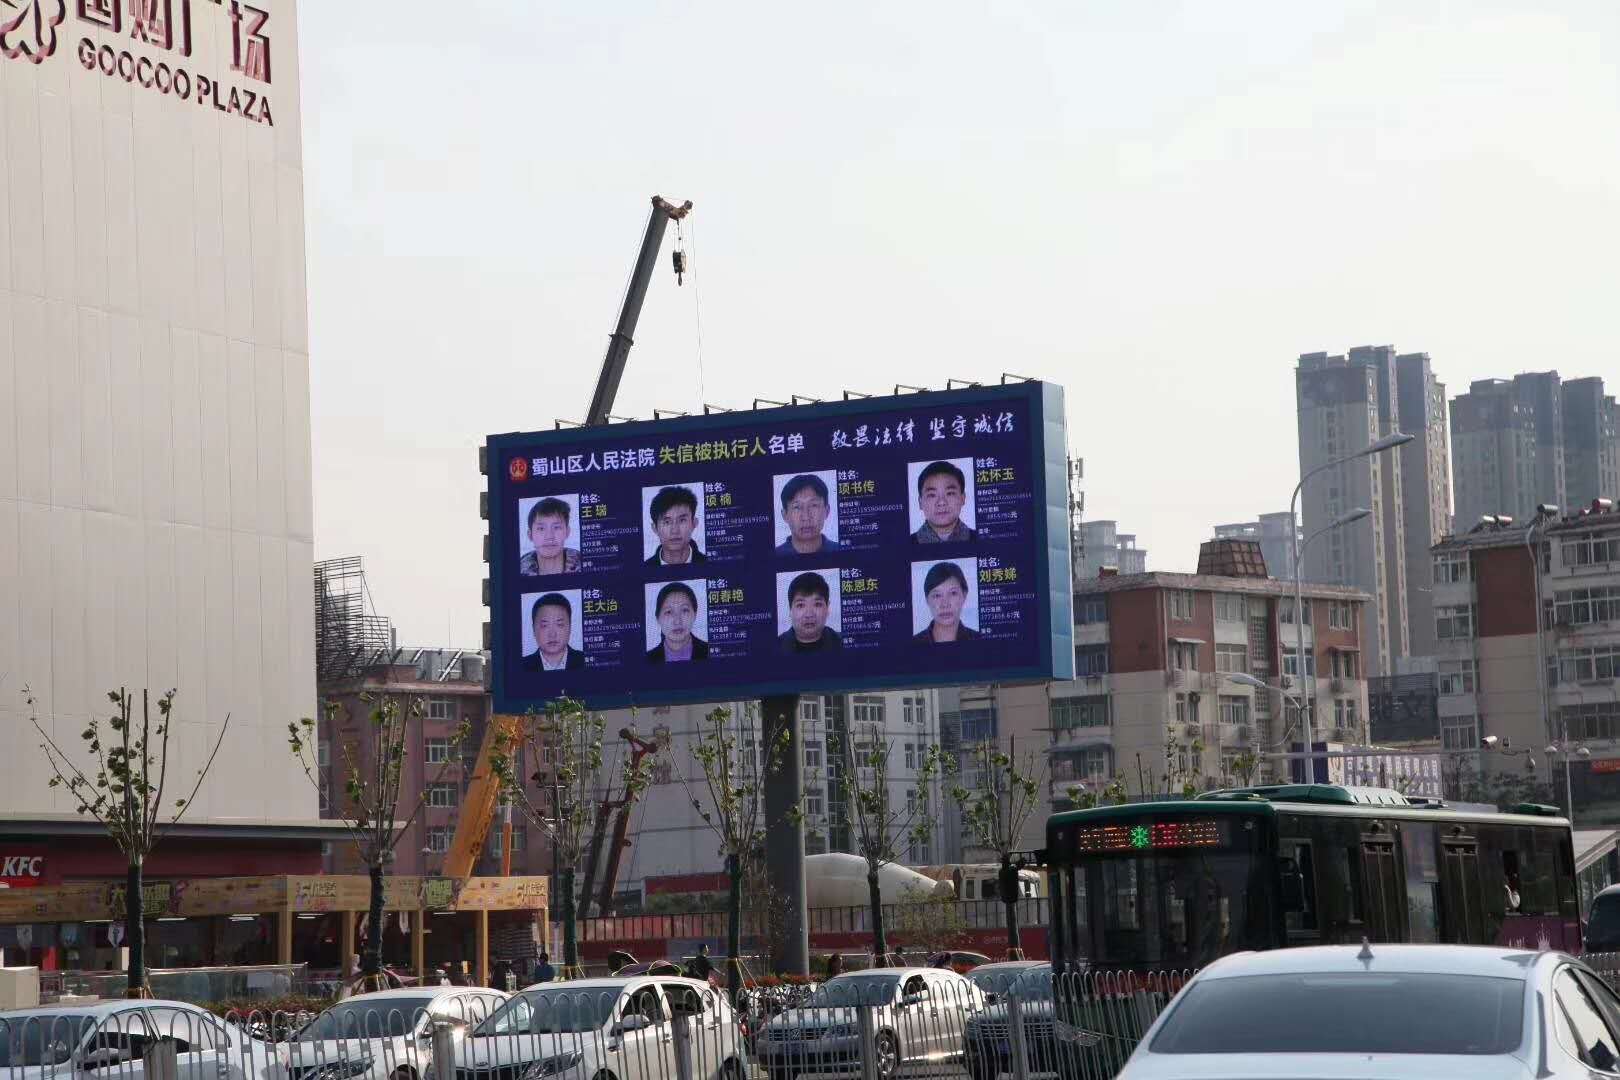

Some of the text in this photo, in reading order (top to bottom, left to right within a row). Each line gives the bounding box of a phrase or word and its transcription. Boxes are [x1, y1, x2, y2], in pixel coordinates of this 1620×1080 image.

[78, 37, 274, 127] GOOCOO PLAZA
[831, 418, 916, 450] 敬畏法律
[532, 447, 656, 477] 蜀山区人民法院
[1, 856, 43, 877] KFC
